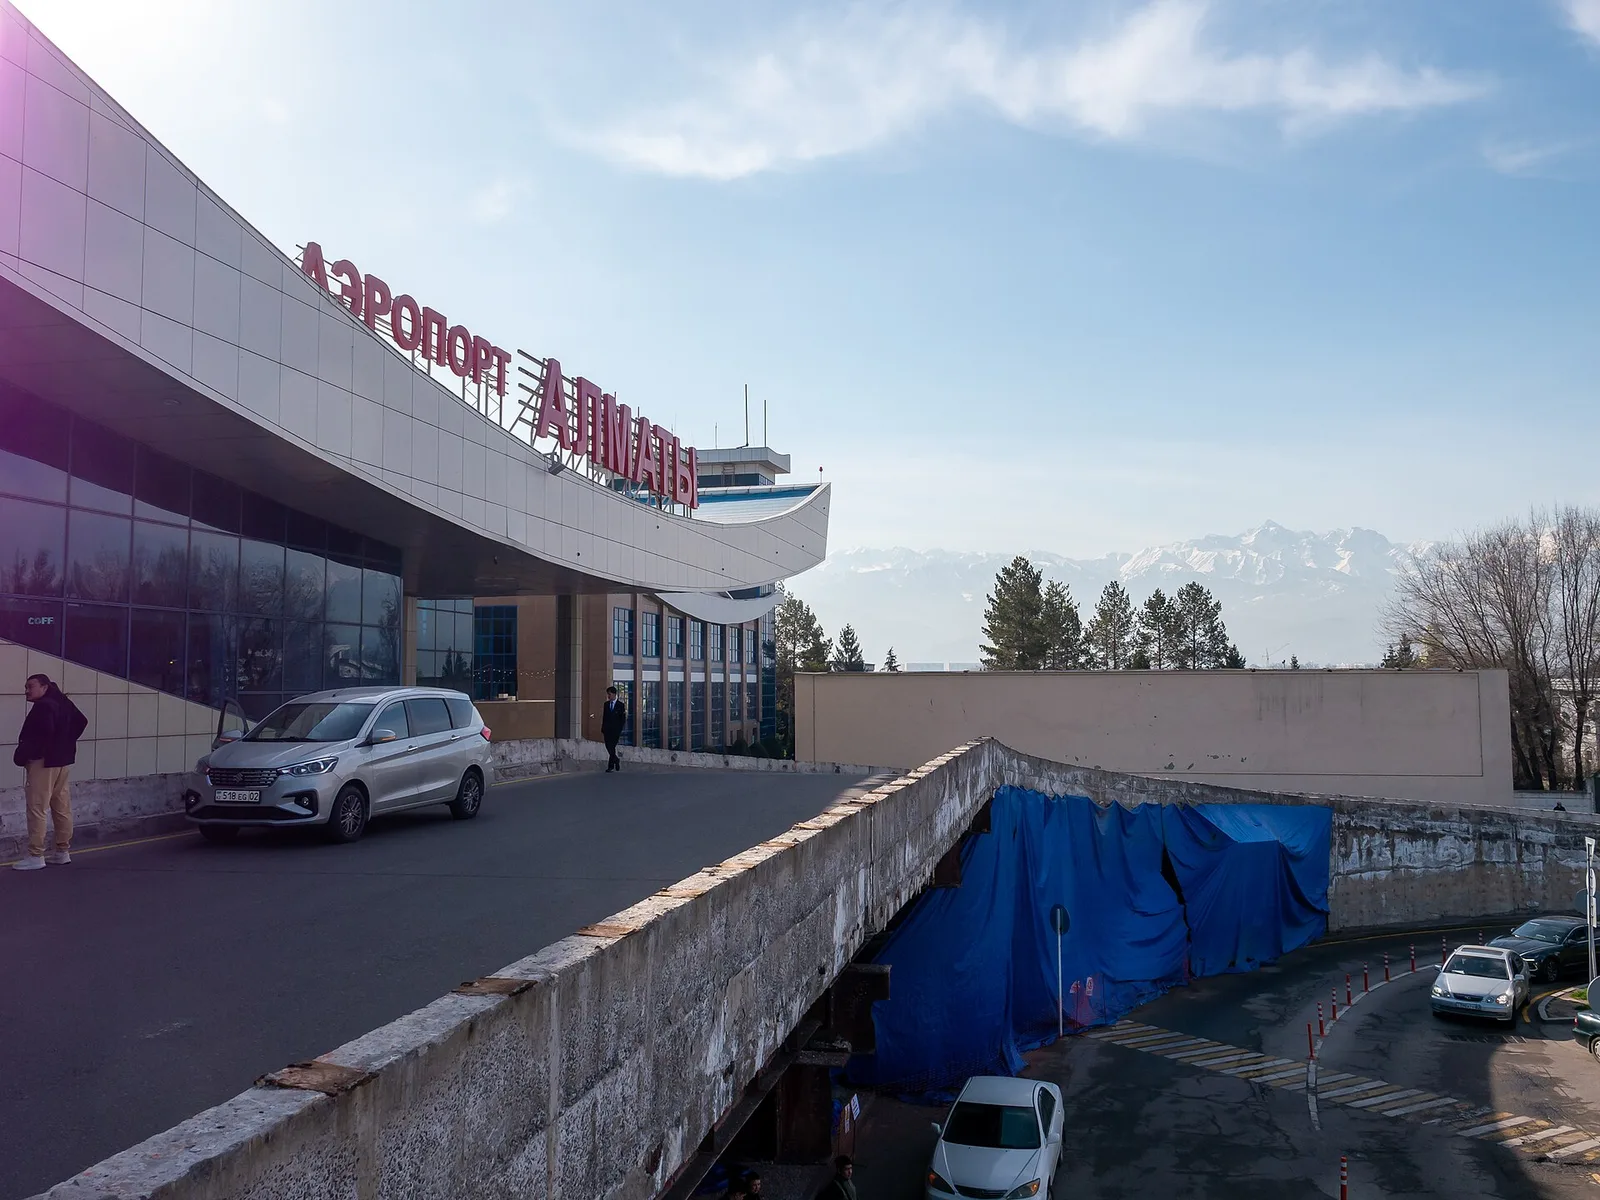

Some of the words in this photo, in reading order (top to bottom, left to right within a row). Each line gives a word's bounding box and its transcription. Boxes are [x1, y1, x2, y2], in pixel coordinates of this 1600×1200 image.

[301, 241, 512, 397] АЭРОПОРТ
[537, 358, 700, 509] АЛМАТЫ
[223, 791, 236, 800] 518
[250, 792, 259, 801] 02
